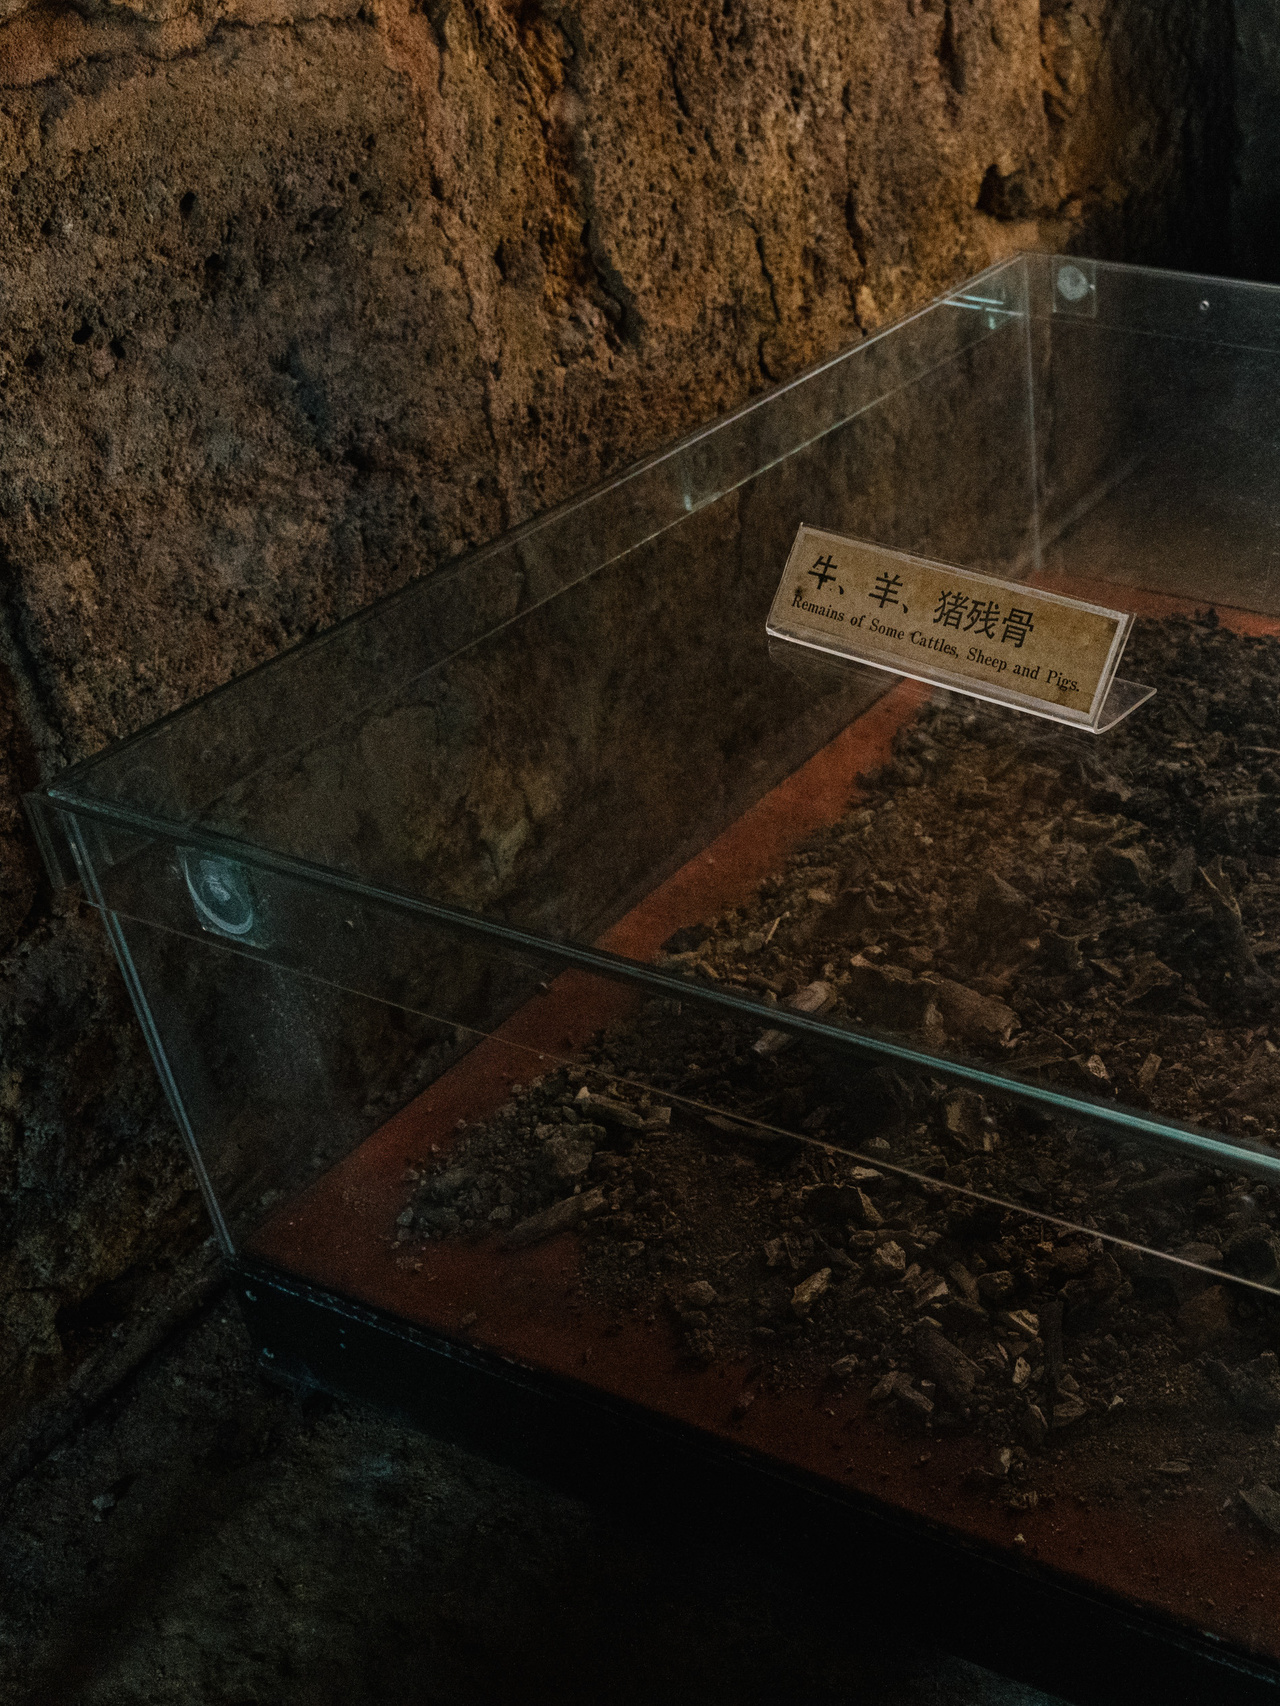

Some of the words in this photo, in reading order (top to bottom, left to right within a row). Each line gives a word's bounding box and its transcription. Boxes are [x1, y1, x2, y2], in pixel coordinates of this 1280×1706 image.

[791, 593, 845, 622] Remains
[849, 614, 866, 628] of
[868, 617, 905, 640] Some
[910, 630, 960, 659] Cattles,
[966, 646, 1008, 673] Sheep
[1012, 662, 1041, 681] and
[1046, 669, 1081, 693] Pigs.
[807, 554, 1034, 648] 牛、羊、猪残骨
